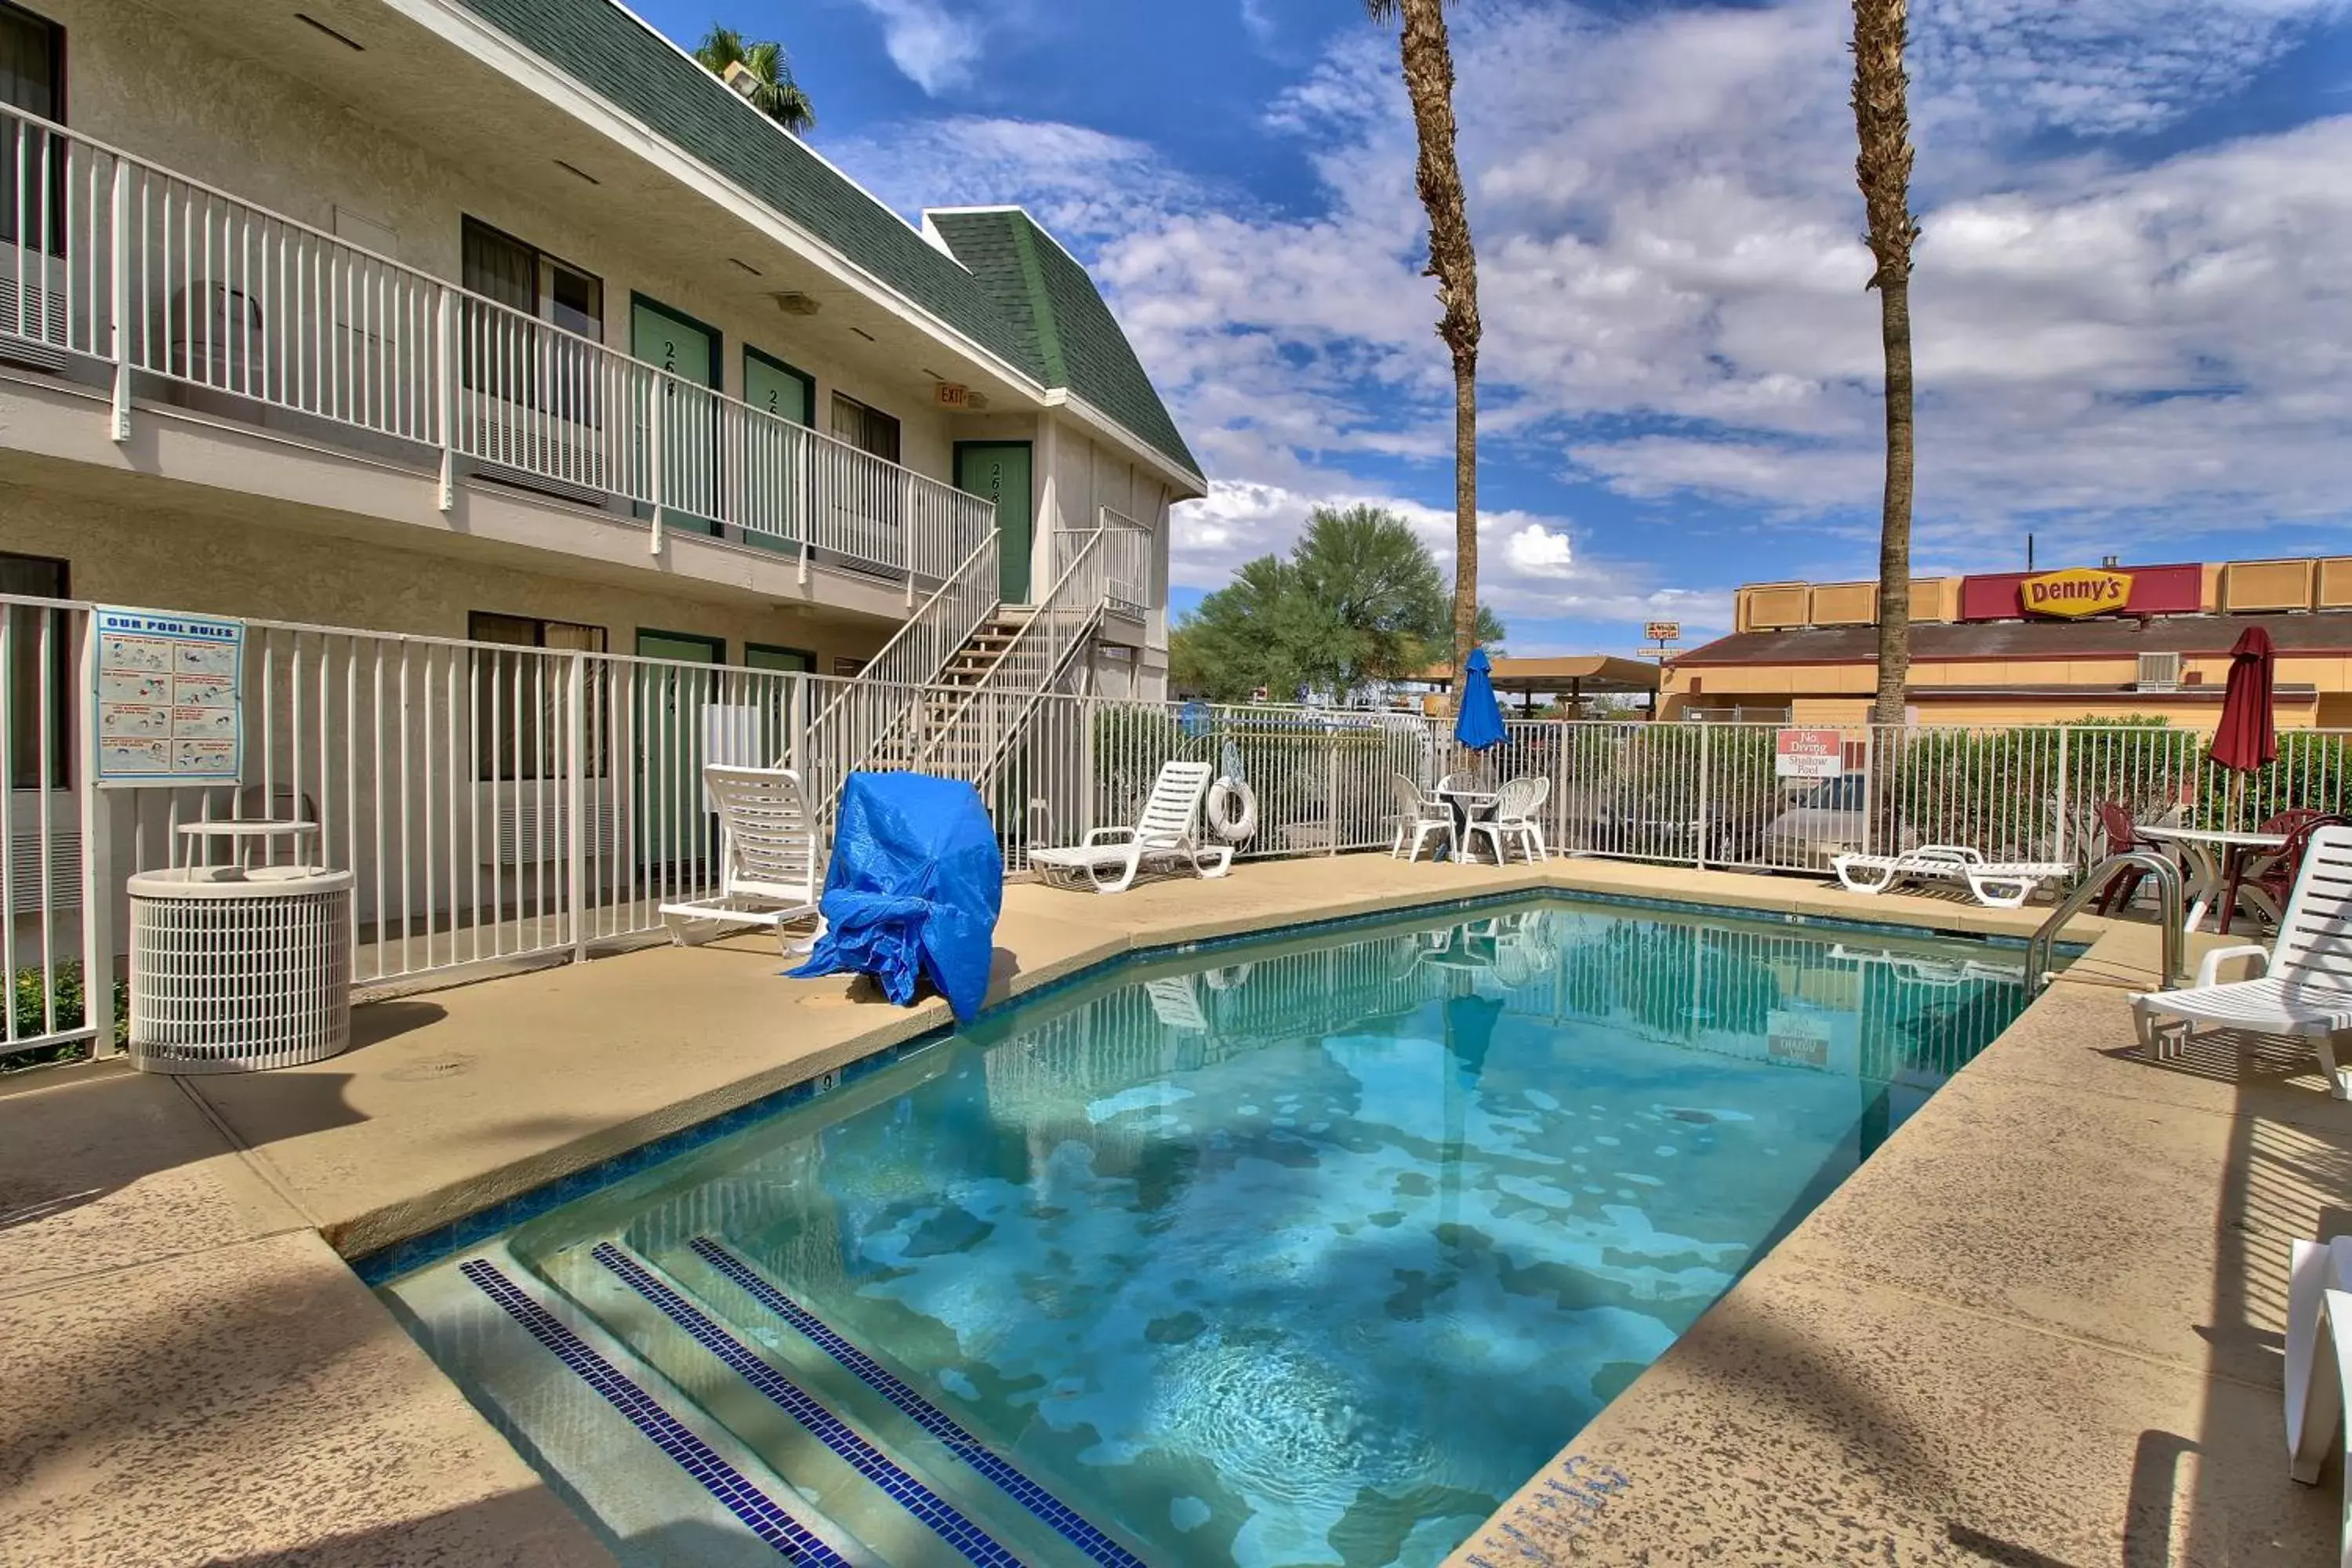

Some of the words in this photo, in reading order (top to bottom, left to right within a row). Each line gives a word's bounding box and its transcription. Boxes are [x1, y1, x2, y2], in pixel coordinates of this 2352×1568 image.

[942, 387, 963, 405] EXIT
[991, 463, 1001, 504] 268
[2032, 576, 2122, 602] Denny's
[107, 617, 142, 629] OUR
[147, 621, 185, 633] POOL
[190, 625, 234, 637] RULES
[1800, 732, 1817, 742] No
[1791, 741, 1828, 756] Diving
[1788, 755, 1828, 766] Shallow
[1797, 764, 1819, 775] Pool
